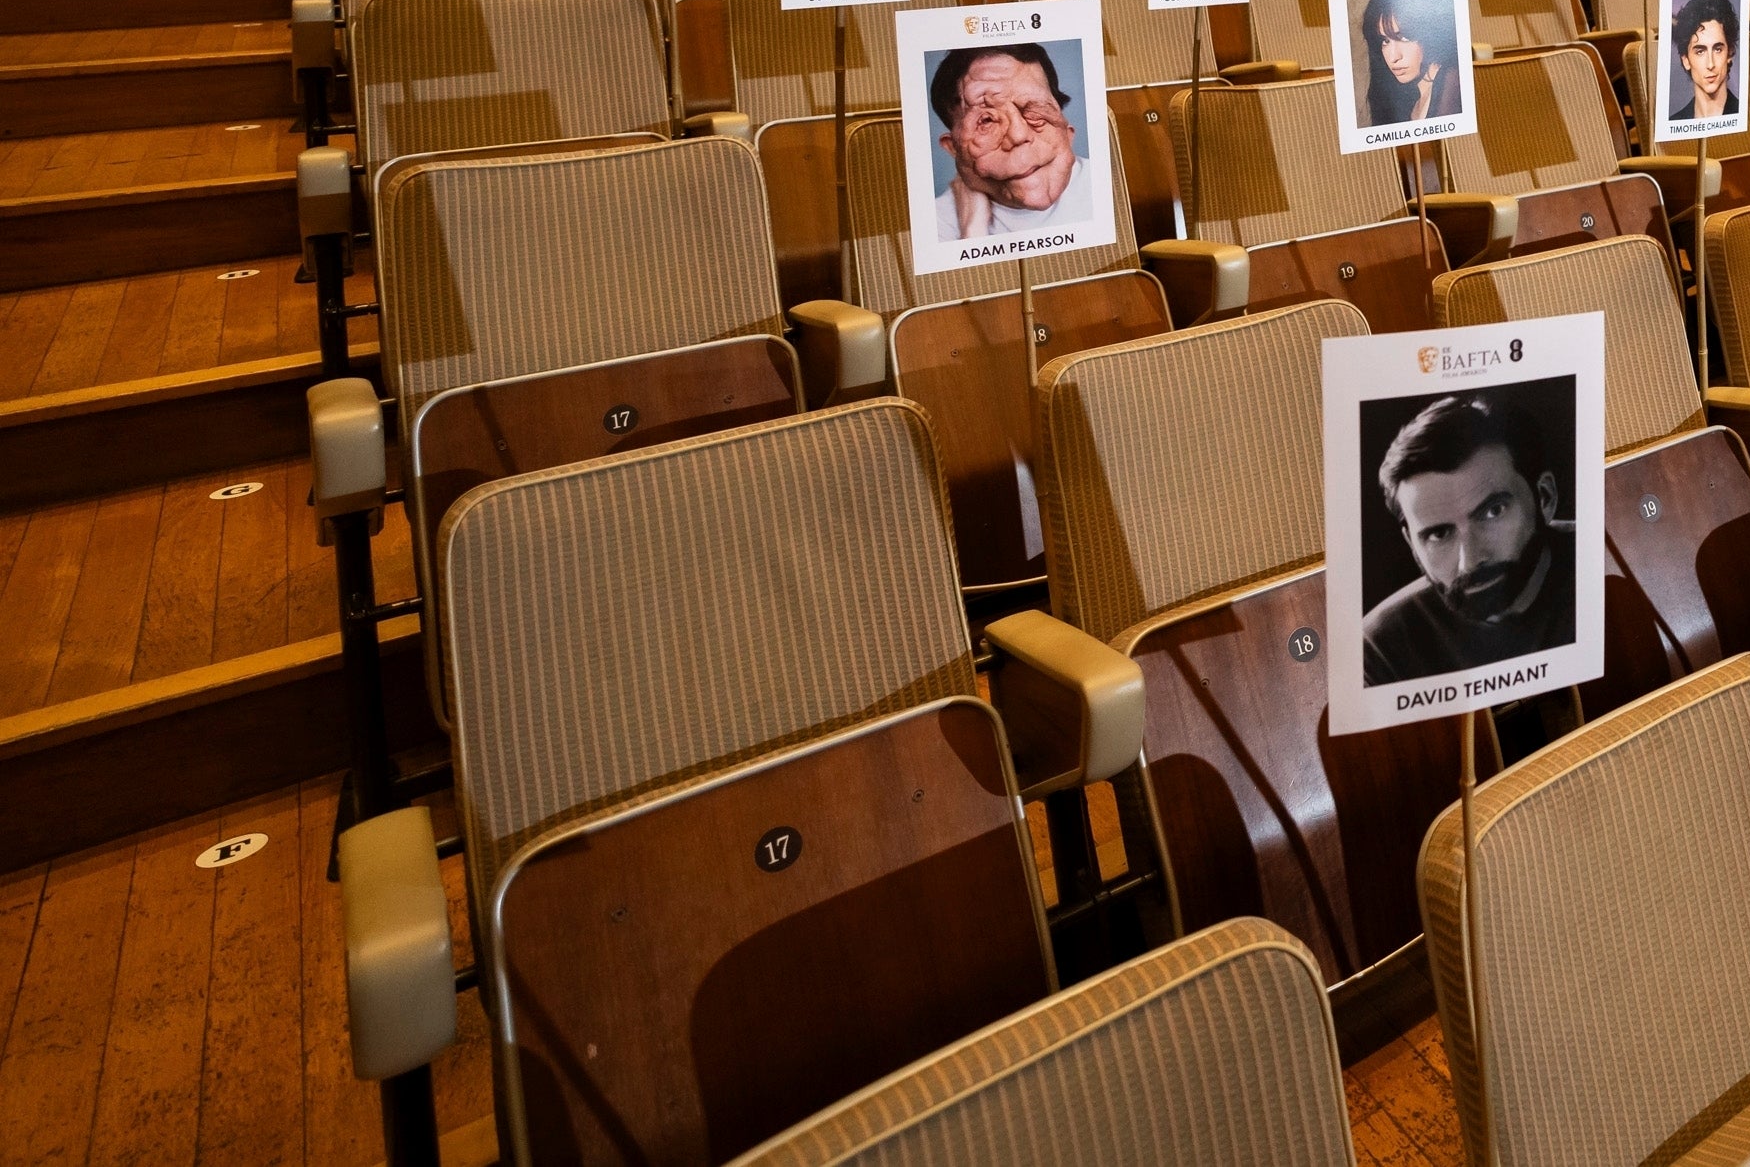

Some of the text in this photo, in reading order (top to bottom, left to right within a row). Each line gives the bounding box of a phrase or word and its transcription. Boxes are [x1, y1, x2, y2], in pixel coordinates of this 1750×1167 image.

[982, 19, 1026, 32] BAFTA
[1146, 112, 1158, 123] 19
[1706, 119, 1738, 131] CHALAMET
[1366, 122, 1456, 144] CAMILLA CABELLO
[1582, 216, 1594, 228] 20
[960, 233, 1074, 261] ADAM PEARSON
[1341, 266, 1354, 279] 19
[1442, 350, 1502, 371] BAFTA
[611, 410, 631, 430] 17
[221, 485, 253, 496] G
[1643, 500, 1657, 518] 19
[1294, 634, 1314, 656] 18
[1397, 663, 1549, 711] DAVID TENNANT
[213, 839, 253, 863] F
[765, 835, 791, 865] 17
